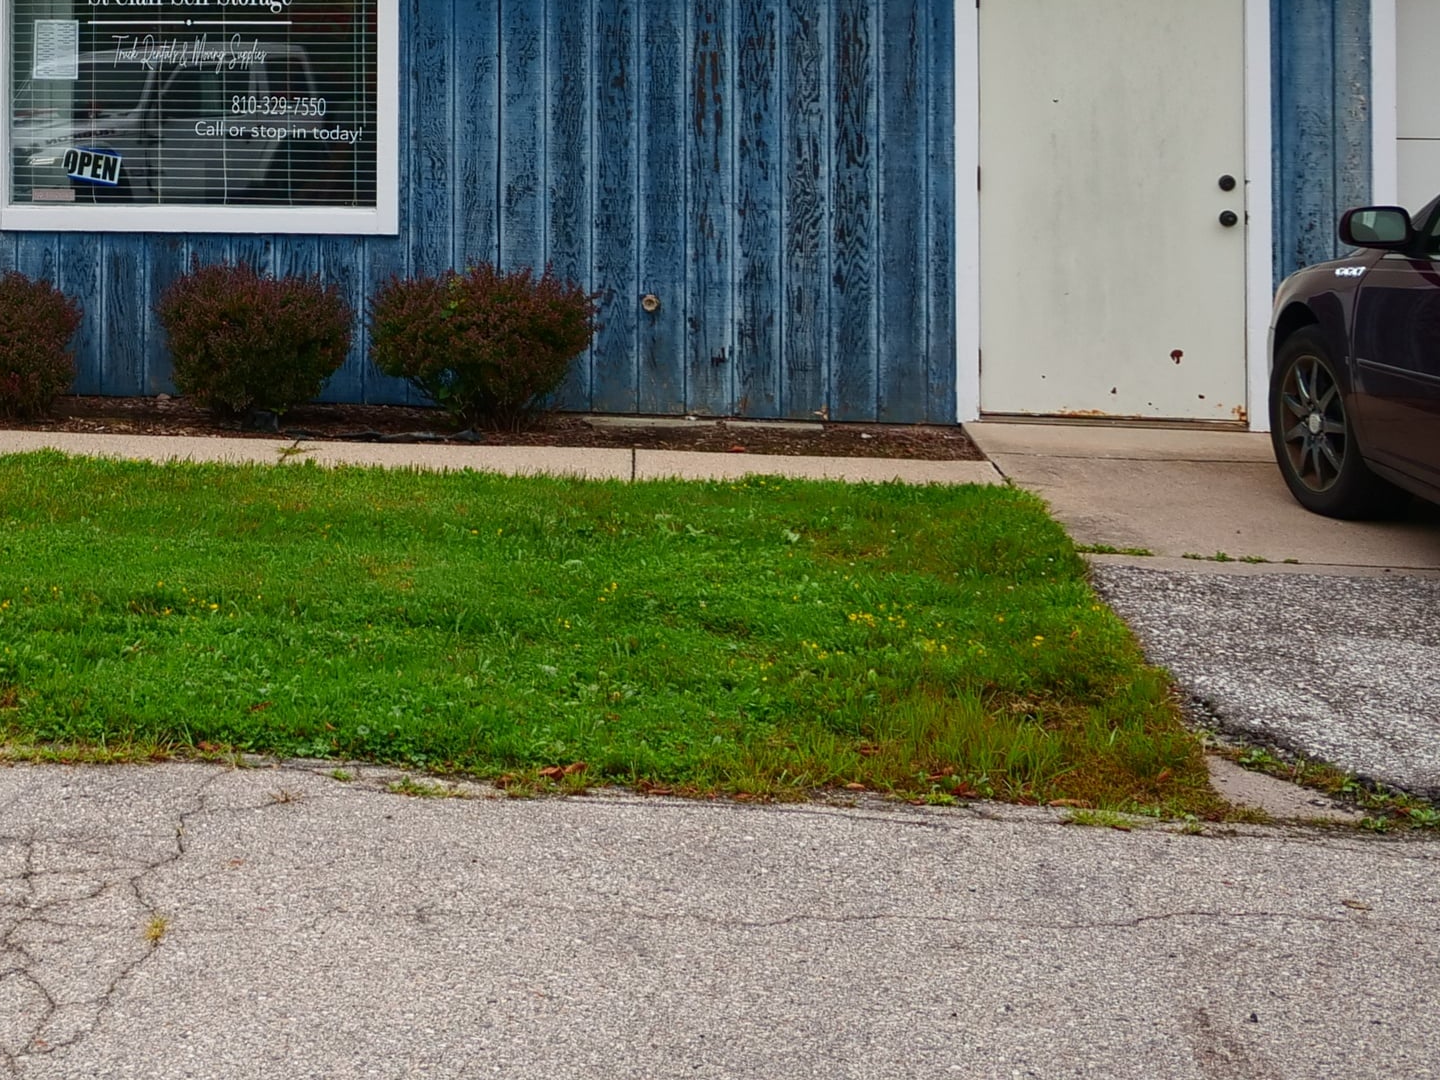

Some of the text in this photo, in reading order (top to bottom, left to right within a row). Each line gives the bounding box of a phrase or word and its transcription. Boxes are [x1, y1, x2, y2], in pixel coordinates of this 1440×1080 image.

[112, 35, 138, 69] Truck
[140, 34, 179, 72] Rentals
[179, 41, 188, 68] &
[191, 32, 226, 74] Moving
[228, 32, 268, 70] Supplies
[231, 95, 327, 117] 810-329-7550
[194, 121, 363, 145] Call or stop in today!
[63, 149, 118, 182] OPEN
